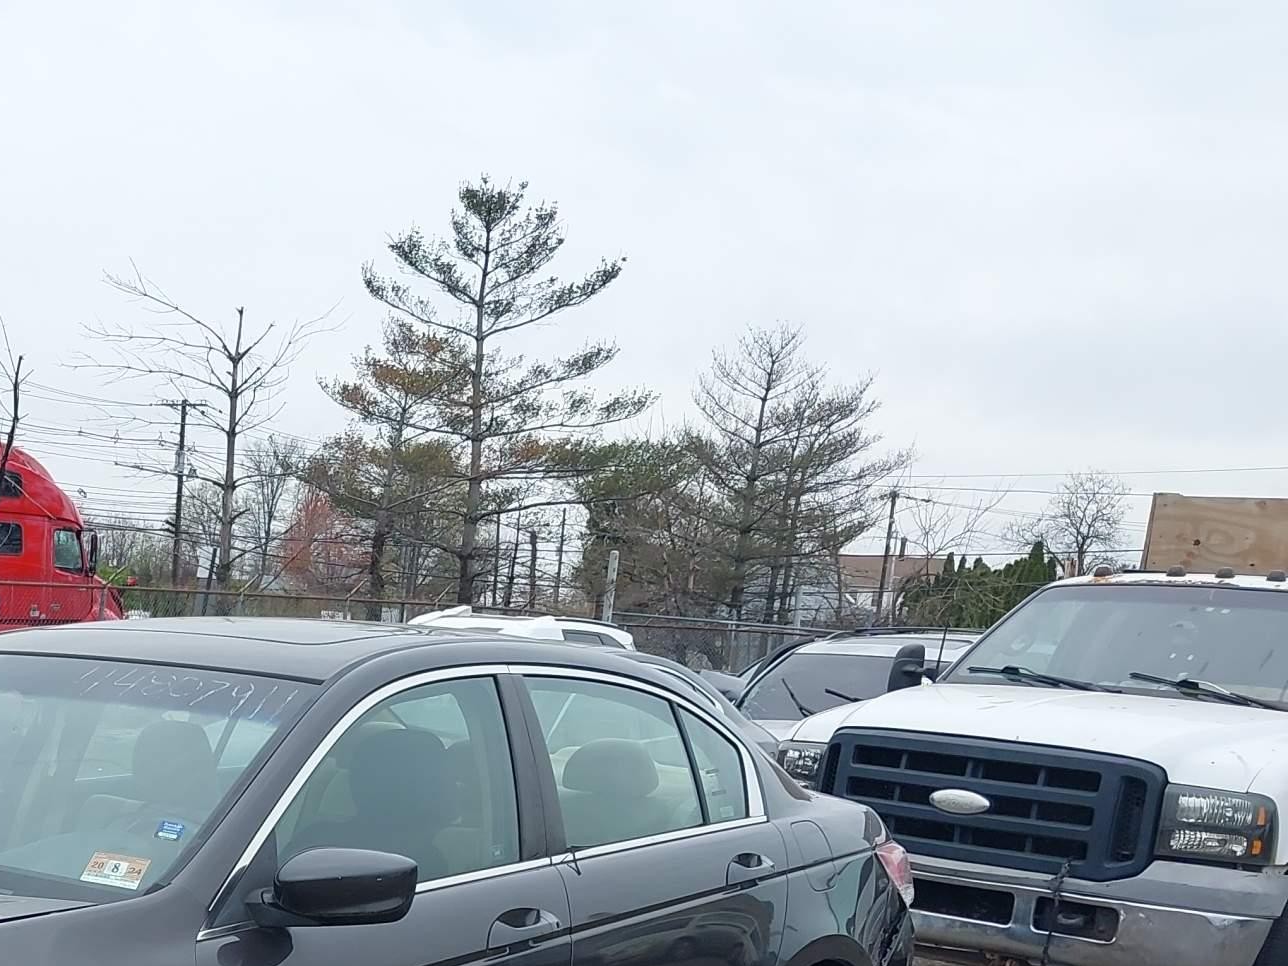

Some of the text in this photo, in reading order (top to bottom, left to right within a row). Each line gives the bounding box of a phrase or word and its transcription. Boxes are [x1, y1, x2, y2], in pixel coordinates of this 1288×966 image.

[91, 860, 143, 876] 20 8 24
